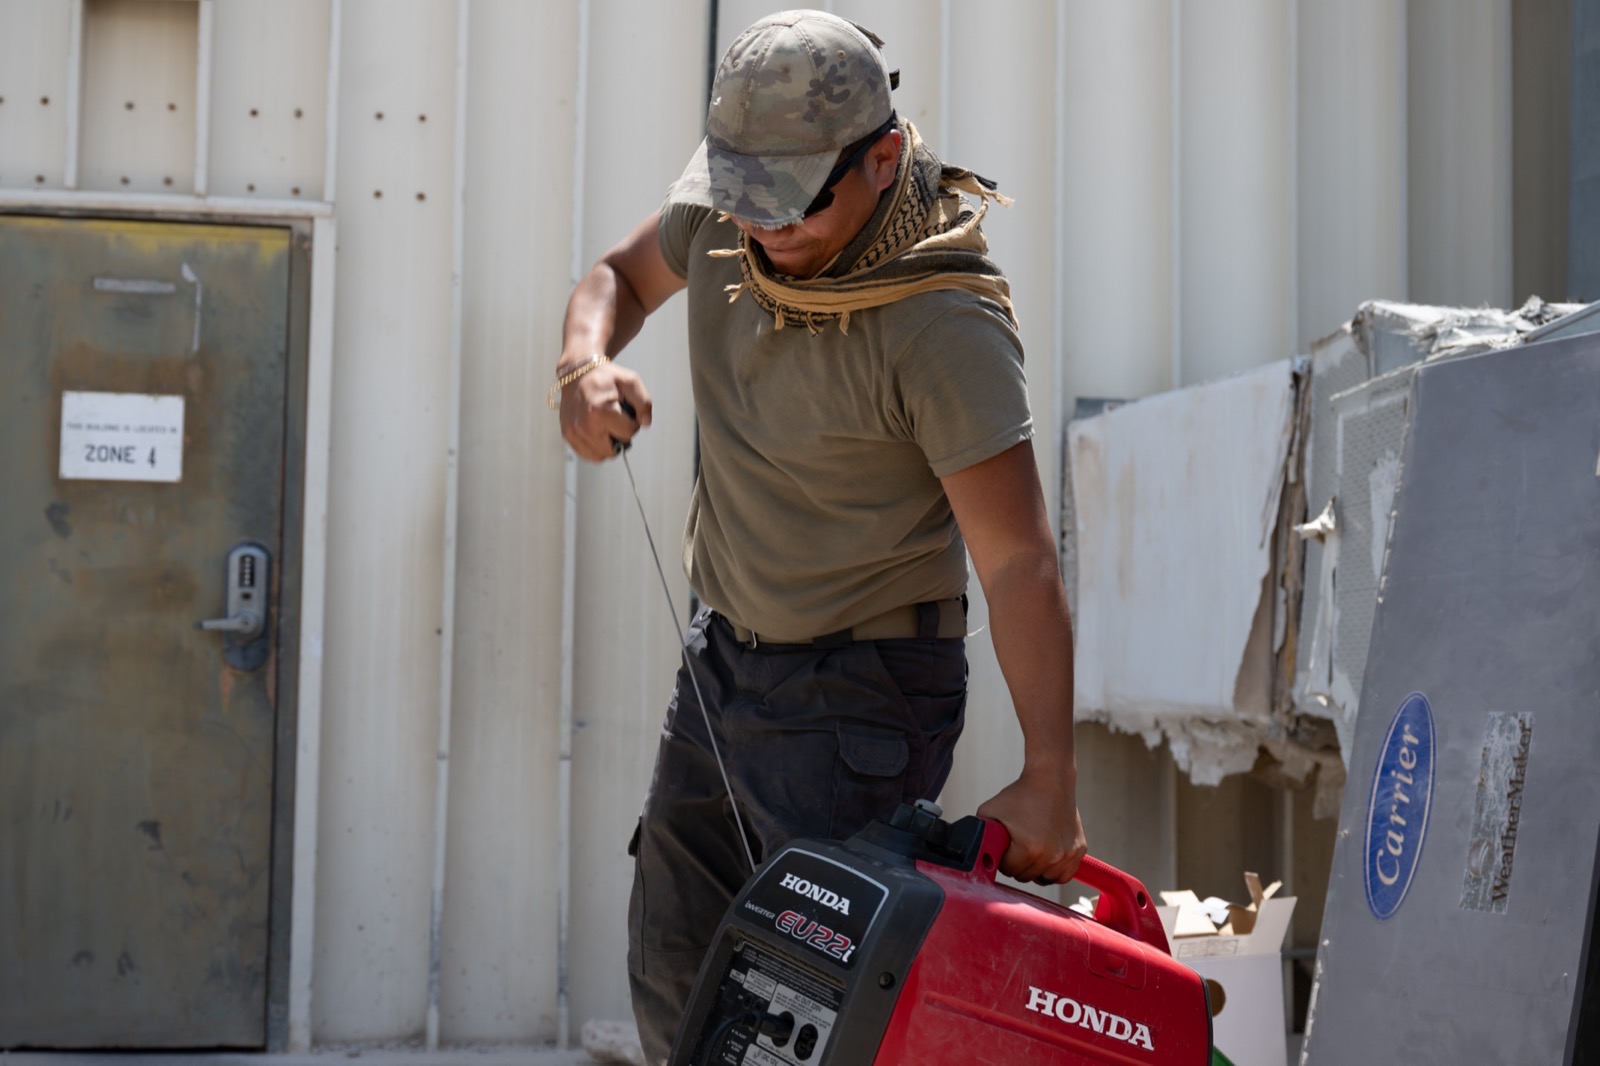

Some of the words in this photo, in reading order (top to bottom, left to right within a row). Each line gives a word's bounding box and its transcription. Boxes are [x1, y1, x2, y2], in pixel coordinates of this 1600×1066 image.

[85, 443, 136, 464] ZONE
[1376, 723, 1419, 886] Carrier
[779, 872, 851, 916] HONDA
[775, 909, 856, 963] EU22i
[1025, 985, 1155, 1051] HONDA
